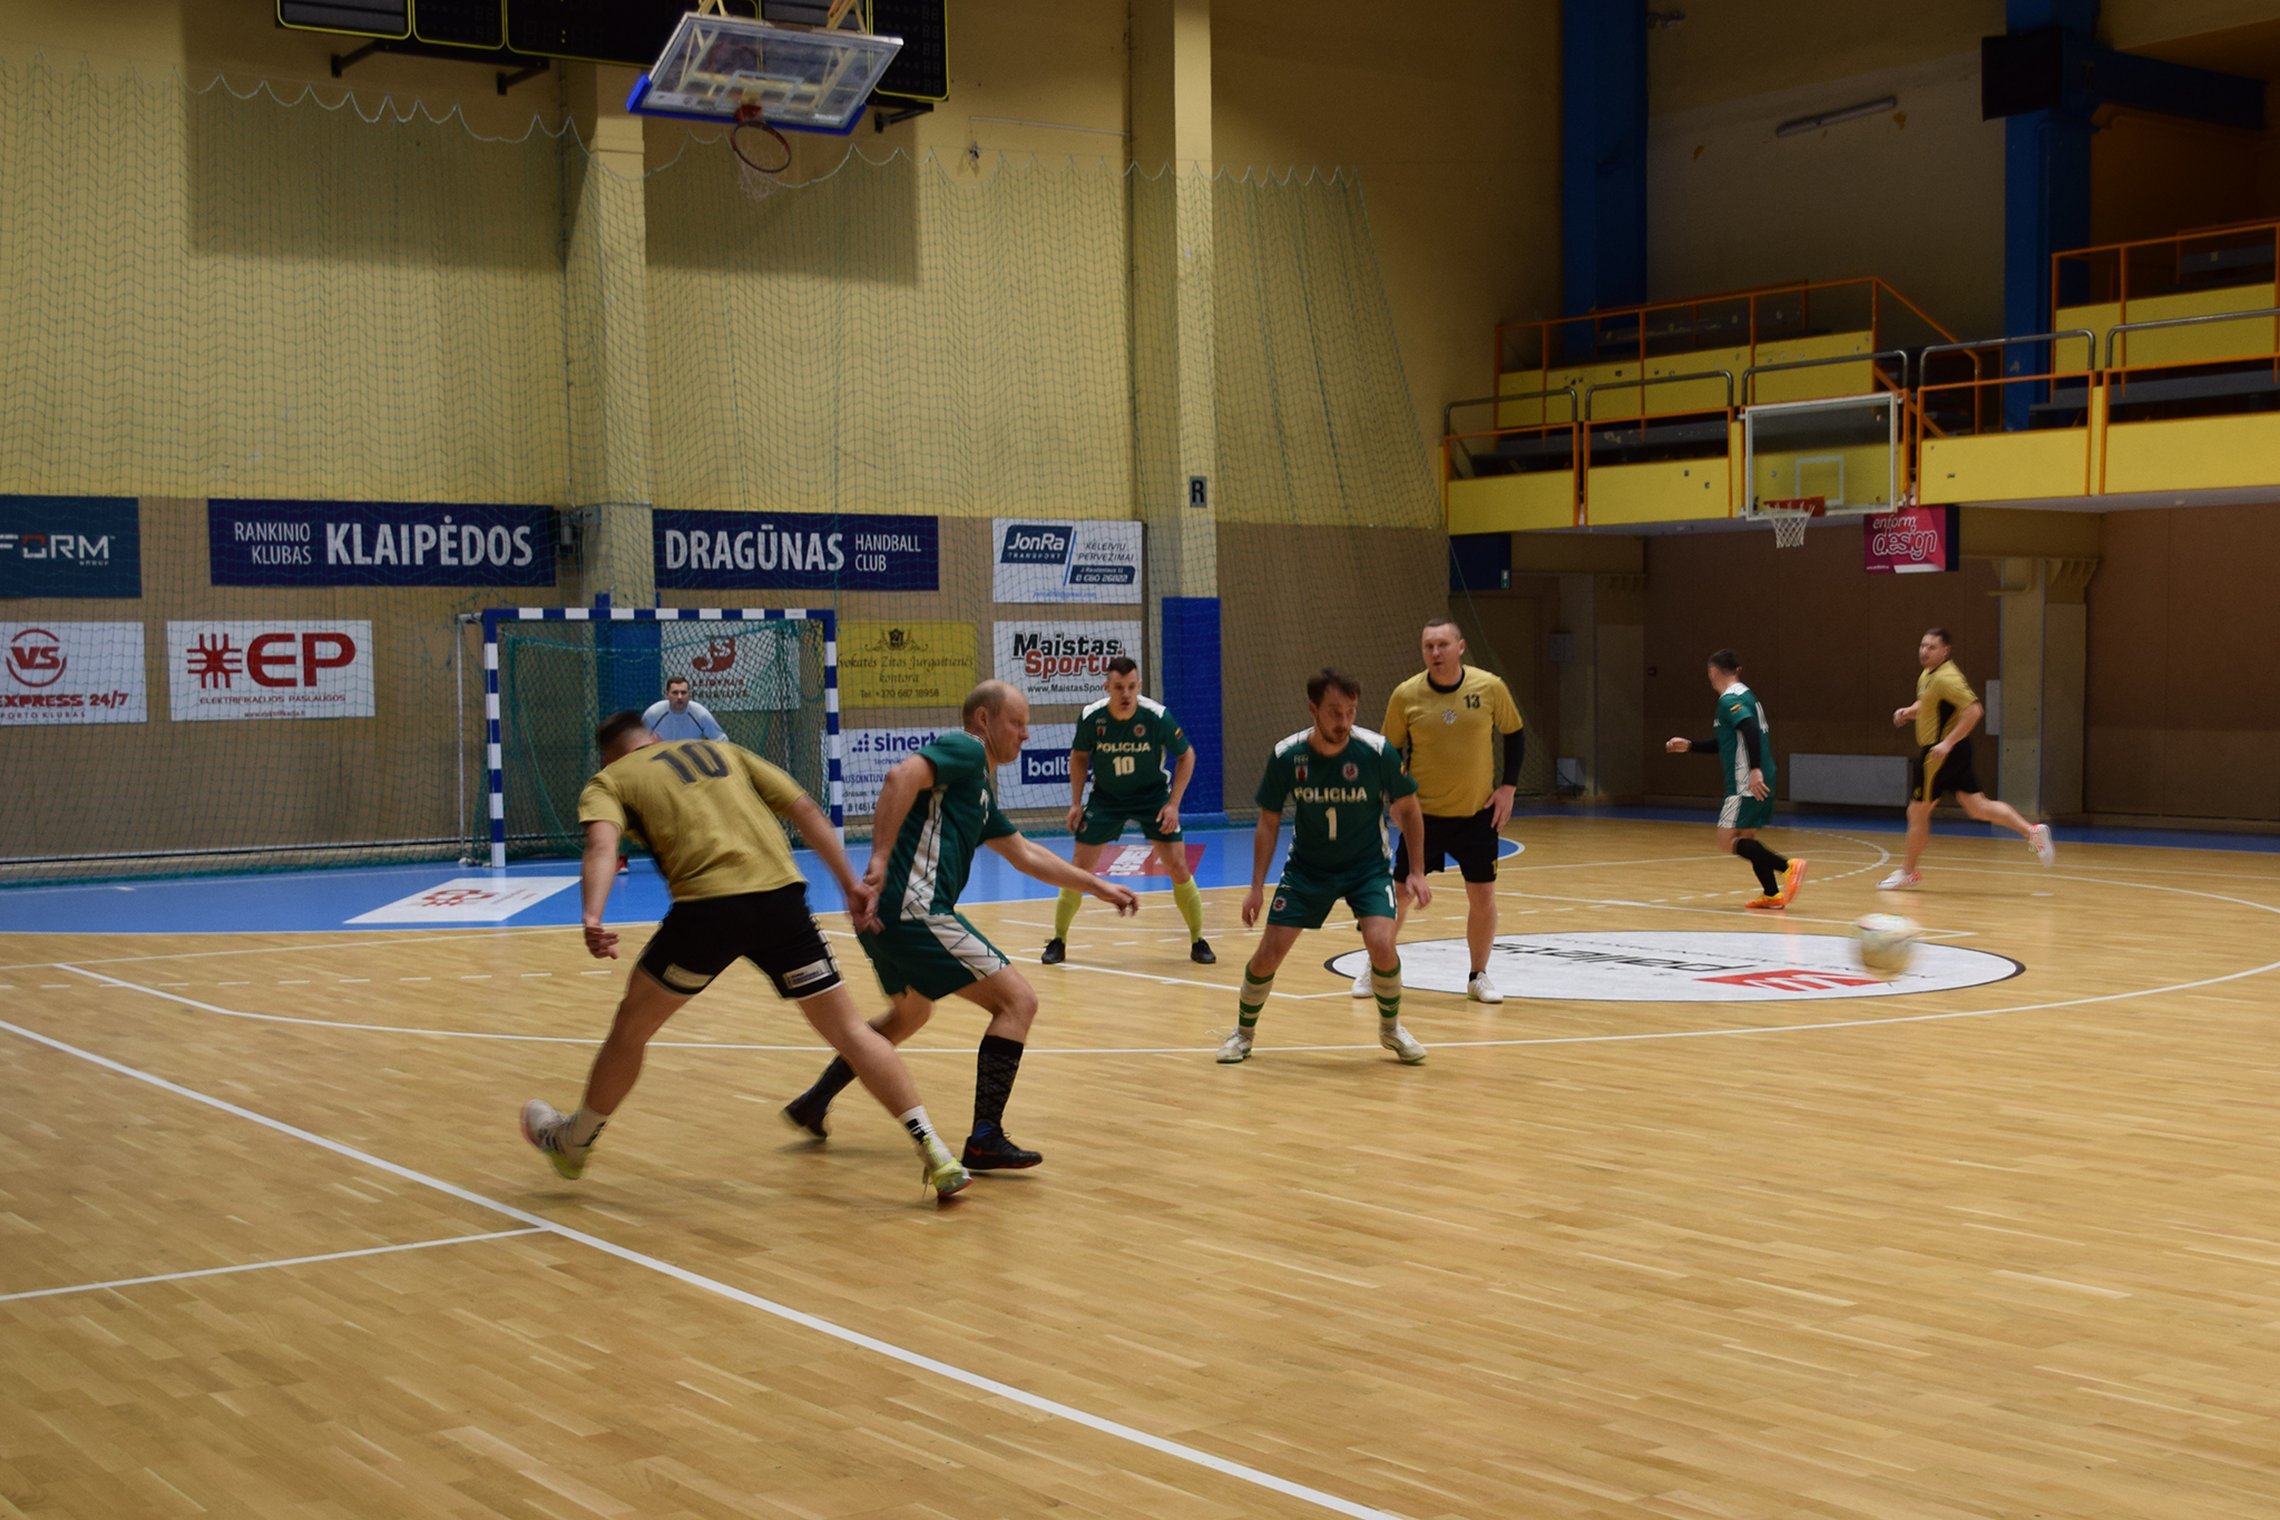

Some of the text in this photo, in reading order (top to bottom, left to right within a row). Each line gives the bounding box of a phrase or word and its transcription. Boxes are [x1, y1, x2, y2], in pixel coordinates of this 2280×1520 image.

[1192, 480, 1204, 503] R
[234, 522, 310, 543] RANKINIO
[326, 515, 532, 567] KLAIPĖDOS
[1008, 532, 1065, 551] JonRa
[665, 524, 845, 571] DRAGŪNAS
[855, 534, 921, 552] HANDBALL
[1872, 526, 1938, 560] design
[252, 545, 311, 565] KLUBAS
[855, 554, 887, 572] CLUB
[1013, 632, 1119, 656] Maistas
[10, 647, 60, 669] VS
[247, 633, 356, 687] EP
[1024, 648, 1123, 680] Sportu
[879, 669, 920, 683] kontora
[288, 694, 346, 702] PASLAUGOS
[1027, 683, 1104, 693] www.MaistasSpor
[89, 690, 128, 709] 24/7
[1464, 694, 1481, 709] 13
[874, 733, 937, 752] sinert
[1096, 741, 1151, 752] POLICIJA
[649, 741, 729, 784] 10
[1028, 756, 1071, 777] balti
[1113, 756, 1135, 776] 10
[1294, 786, 1367, 801] POLICIJA
[1325, 807, 1337, 841] 1
